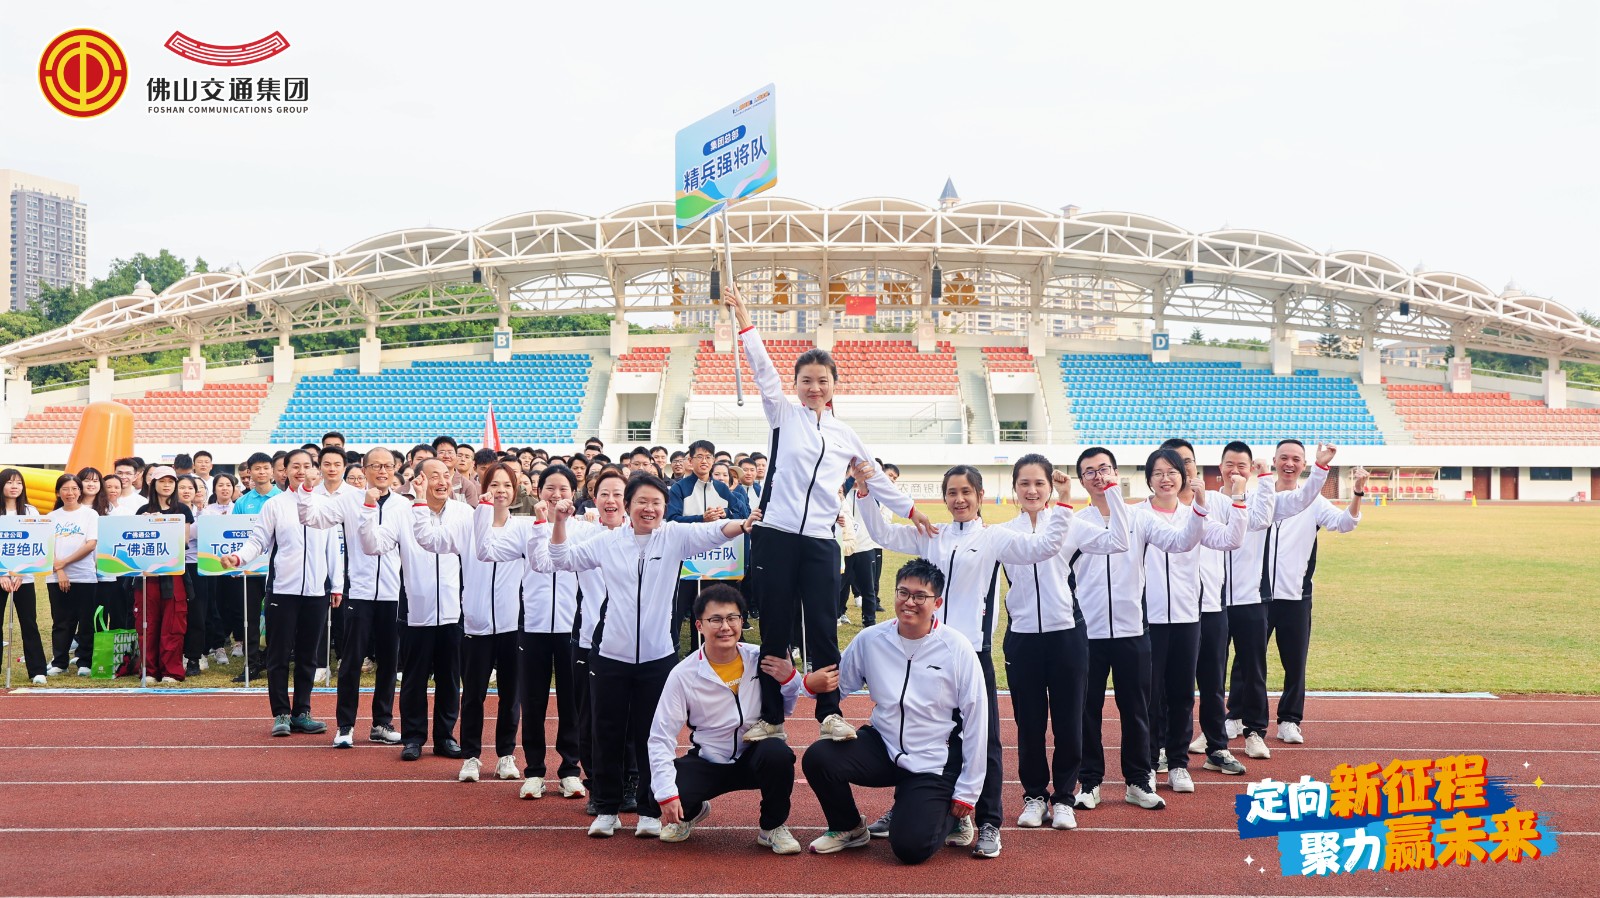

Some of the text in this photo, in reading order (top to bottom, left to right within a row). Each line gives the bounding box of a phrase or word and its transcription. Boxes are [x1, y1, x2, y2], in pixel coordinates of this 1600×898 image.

[710, 129, 740, 151] 集团总部
[683, 135, 767, 193] 精兵强将队
[497, 334, 507, 347] B
[1155, 335, 1166, 348] D
[125, 531, 157, 539] 广佛通公司
[1, 542, 46, 556] 超绝队
[112, 542, 170, 557] 广佛通队
